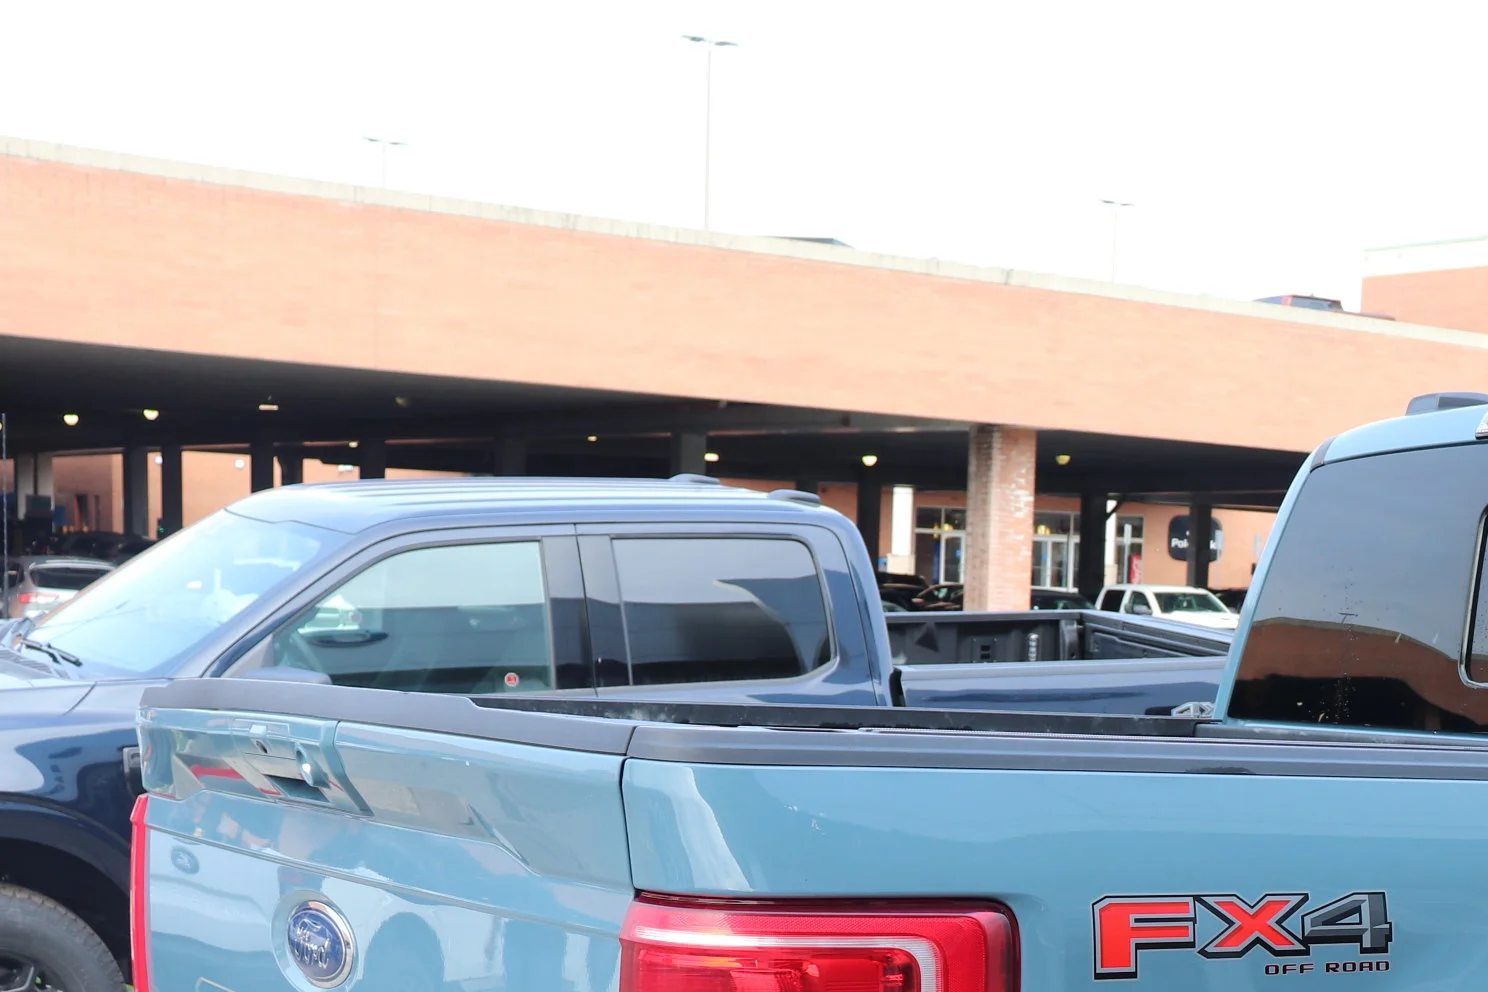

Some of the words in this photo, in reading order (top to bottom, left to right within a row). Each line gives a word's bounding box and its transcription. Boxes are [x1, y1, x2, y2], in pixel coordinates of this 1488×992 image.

[1171, 538, 1190, 548] Pol
[291, 917, 332, 969] Ford
[1092, 892, 1392, 980] FX4
[1264, 963, 1314, 975] OFF
[1326, 961, 1390, 973] ROAD
